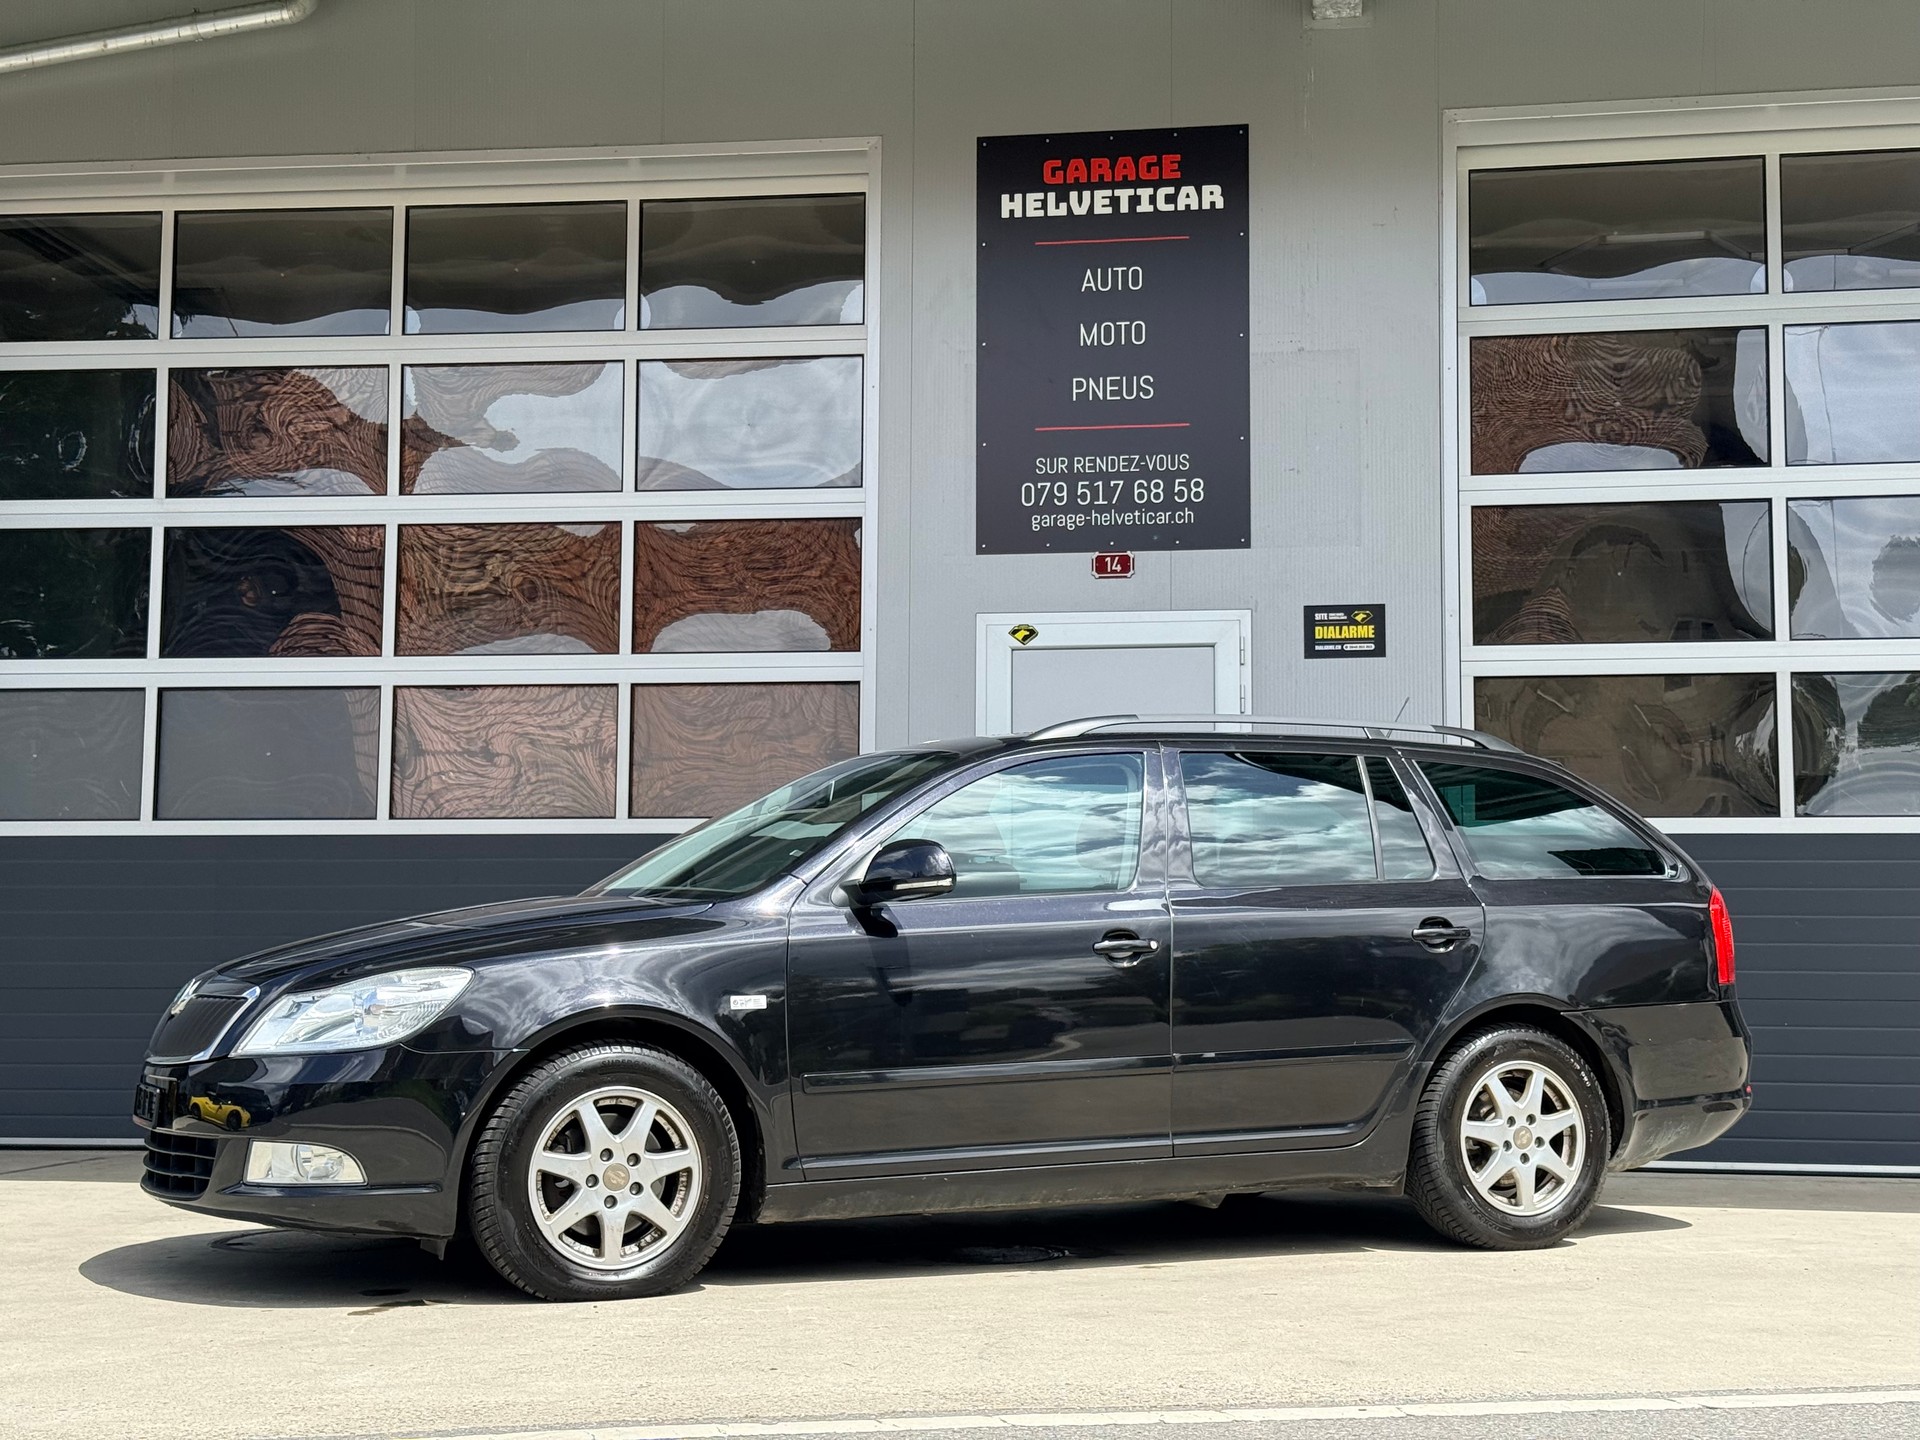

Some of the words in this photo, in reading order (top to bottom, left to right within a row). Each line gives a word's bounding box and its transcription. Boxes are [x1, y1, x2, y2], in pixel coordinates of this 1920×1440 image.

[1043, 154, 1182, 184] GARAGE
[1001, 185, 1225, 219] HELVETICAR
[1081, 266, 1143, 293] AUTO
[1079, 320, 1146, 347] MOTO
[1072, 375, 1154, 402] PNEUS
[1035, 456, 1069, 475] SUR
[1074, 453, 1190, 474] RENDEZ-VOUS
[1021, 482, 1068, 507] 079
[1076, 480, 1124, 506] 517
[1134, 479, 1164, 504] 68
[1174, 477, 1205, 503] 58
[1031, 508, 1194, 531] garage-helveticar.ch
[1104, 557, 1122, 573] 14
[1314, 625, 1375, 640] DIALARME
